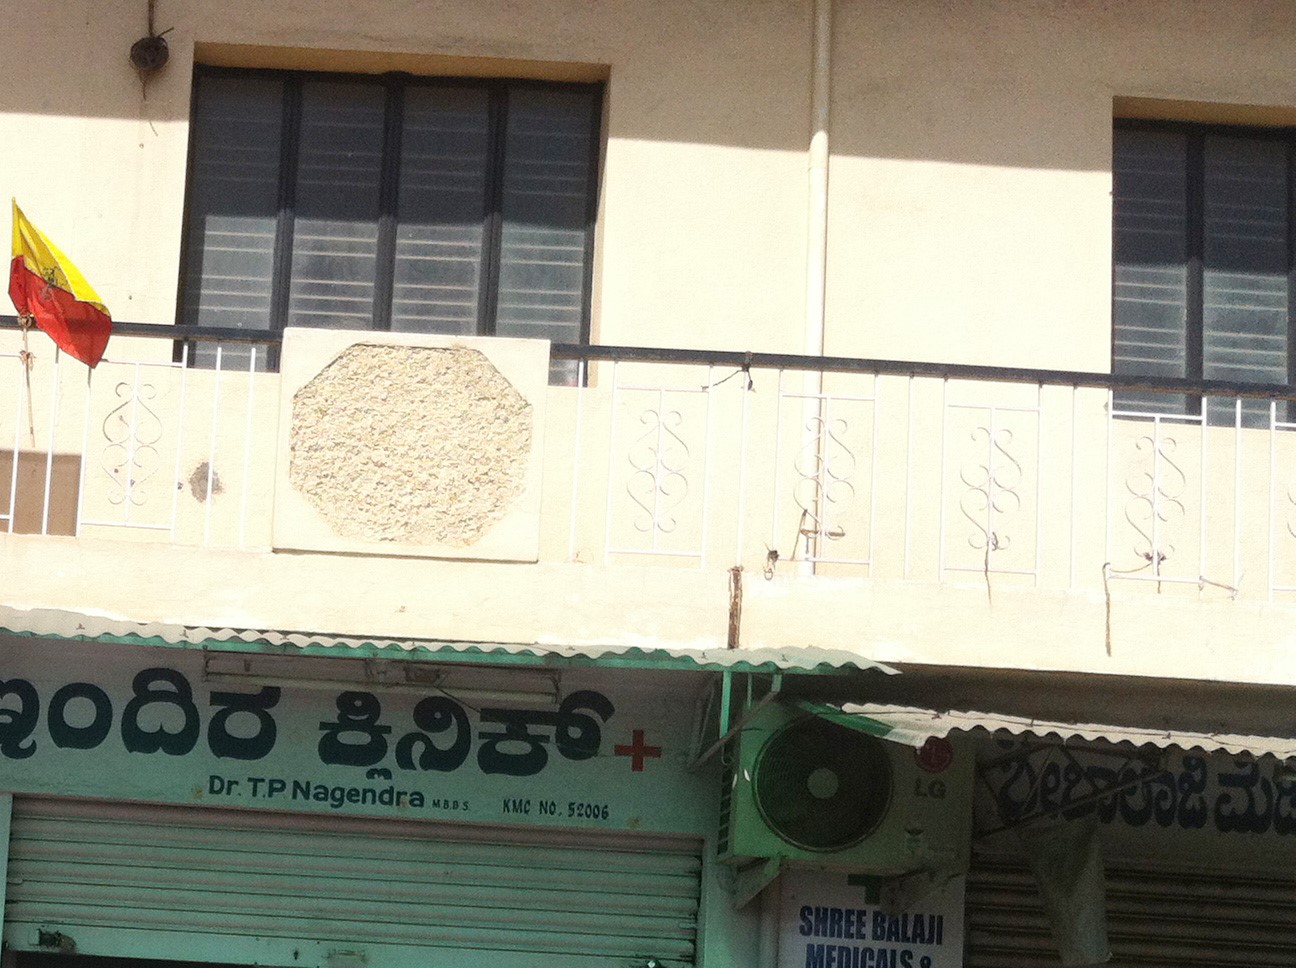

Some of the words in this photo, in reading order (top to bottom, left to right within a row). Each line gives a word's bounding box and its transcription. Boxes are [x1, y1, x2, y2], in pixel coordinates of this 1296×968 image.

[209, 775, 242, 796] Dr.
[292, 781, 426, 808] Nagendra
[504, 798, 531, 815] KMC
[568, 802, 610, 821] 52006
[799, 905, 867, 940] SHREE
[872, 910, 943, 946] BALAJI
